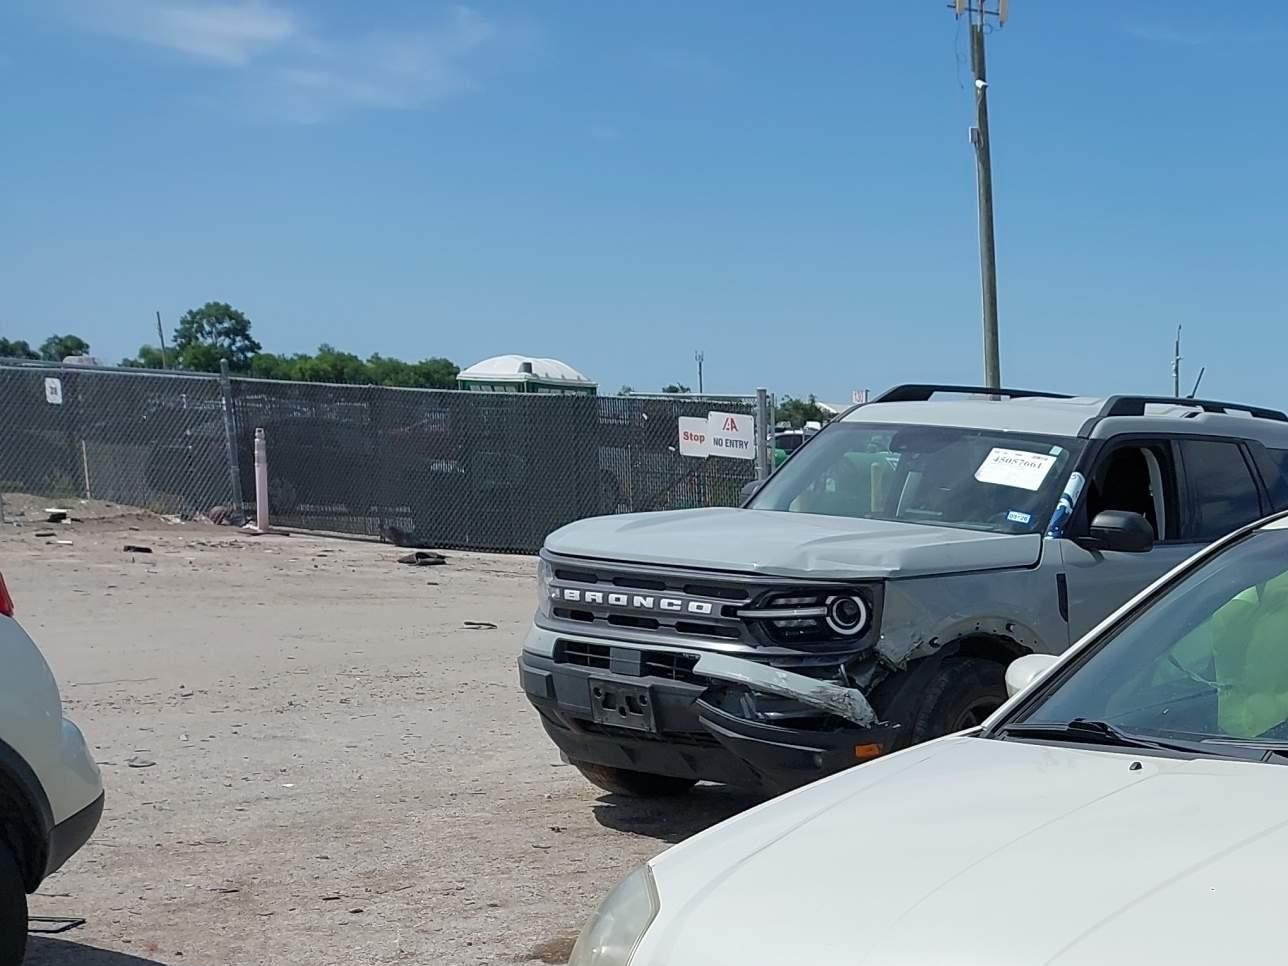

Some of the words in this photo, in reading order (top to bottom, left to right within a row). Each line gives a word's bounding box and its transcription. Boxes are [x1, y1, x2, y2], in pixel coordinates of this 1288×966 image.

[683, 431, 705, 444] Stop
[713, 437, 724, 448] NO
[724, 438, 749, 449] ENTRY
[563, 589, 713, 614] BRONCO
